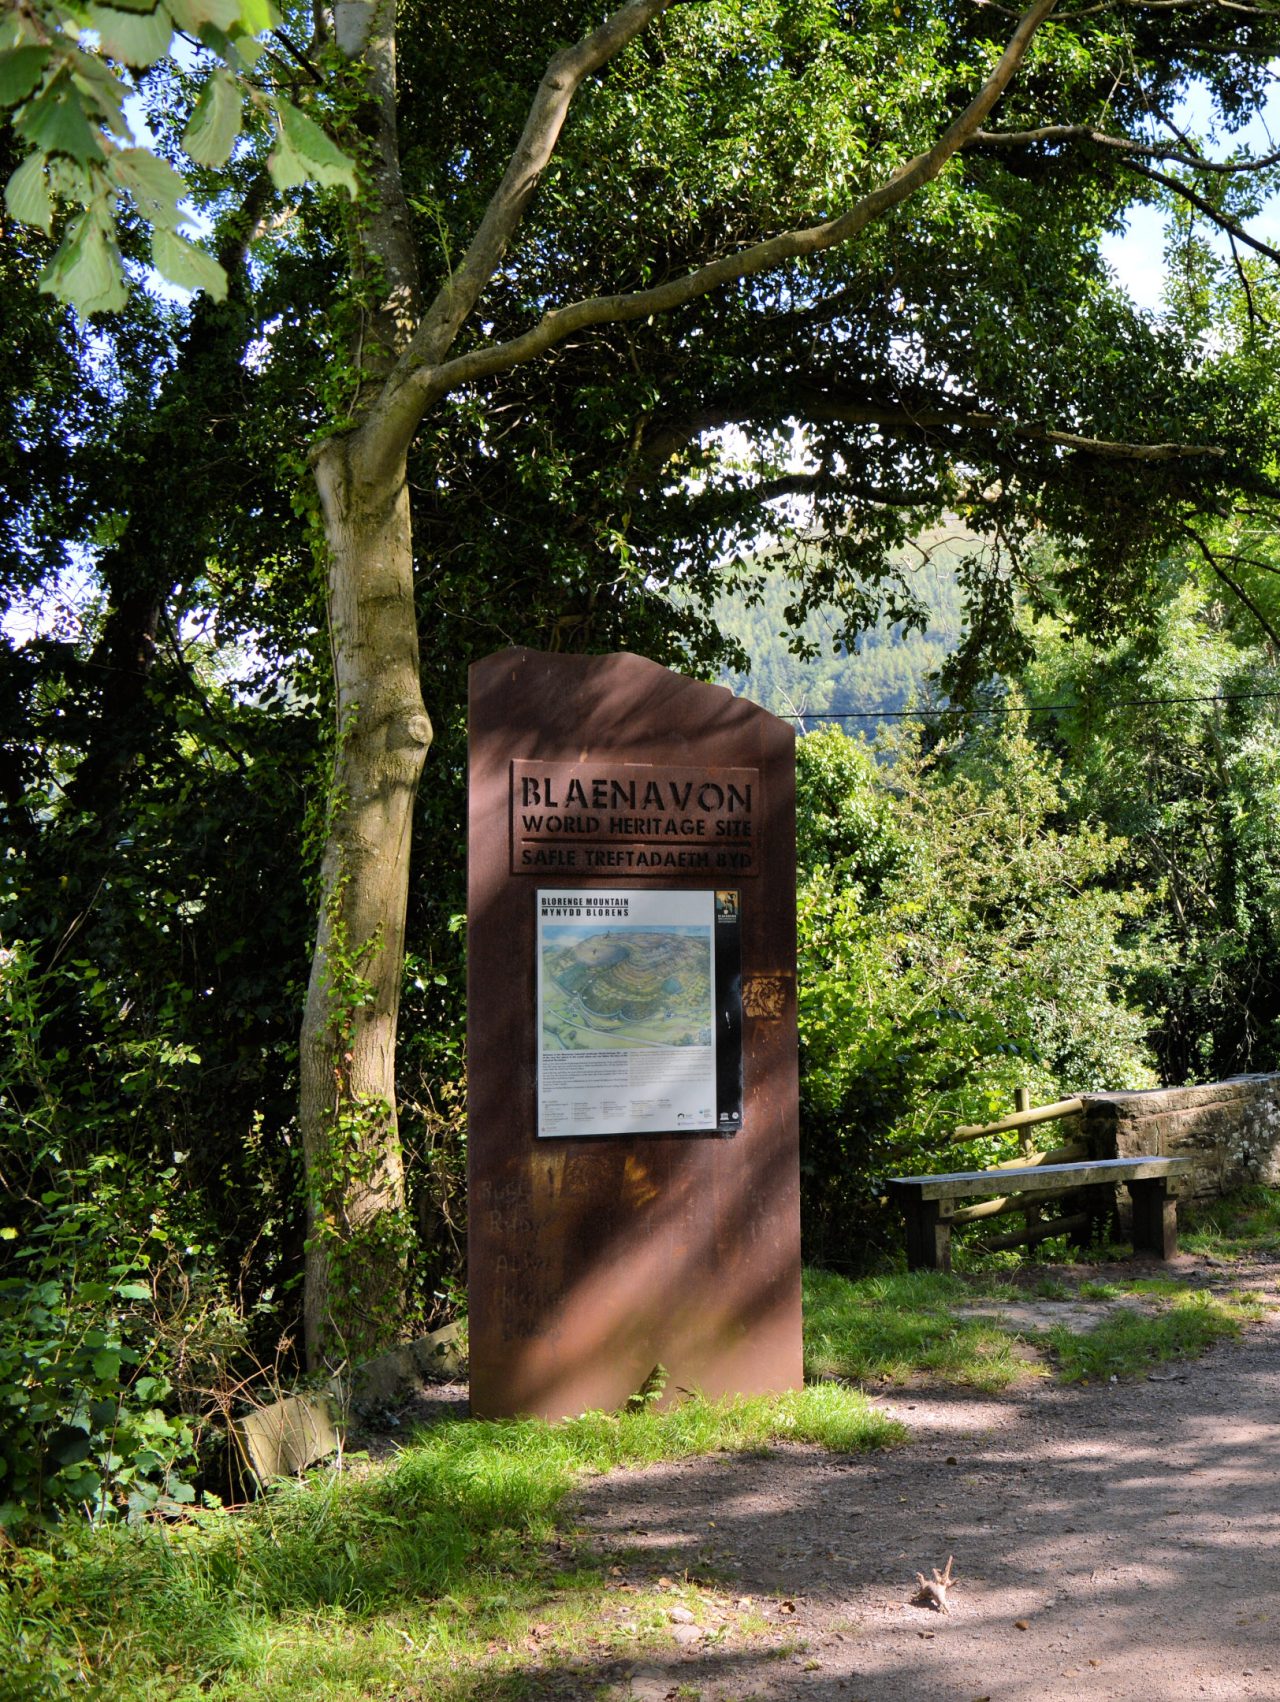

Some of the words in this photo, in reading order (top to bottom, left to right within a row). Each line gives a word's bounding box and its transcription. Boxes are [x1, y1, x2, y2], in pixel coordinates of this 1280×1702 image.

[521, 777, 751, 812] BLAENAVON
[522, 815, 600, 833] WORLD
[610, 817, 705, 836] HERITAGE
[716, 820, 751, 837] SITE
[522, 849, 575, 866] SAFLE
[585, 850, 709, 868] TREFTADAETH
[716, 852, 751, 868] BYD
[541, 897, 583, 906] BLORENGE
[586, 898, 629, 906] MOUNTAIN
[541, 908, 581, 916] MYNYDD
[586, 908, 629, 916] BLORENS
